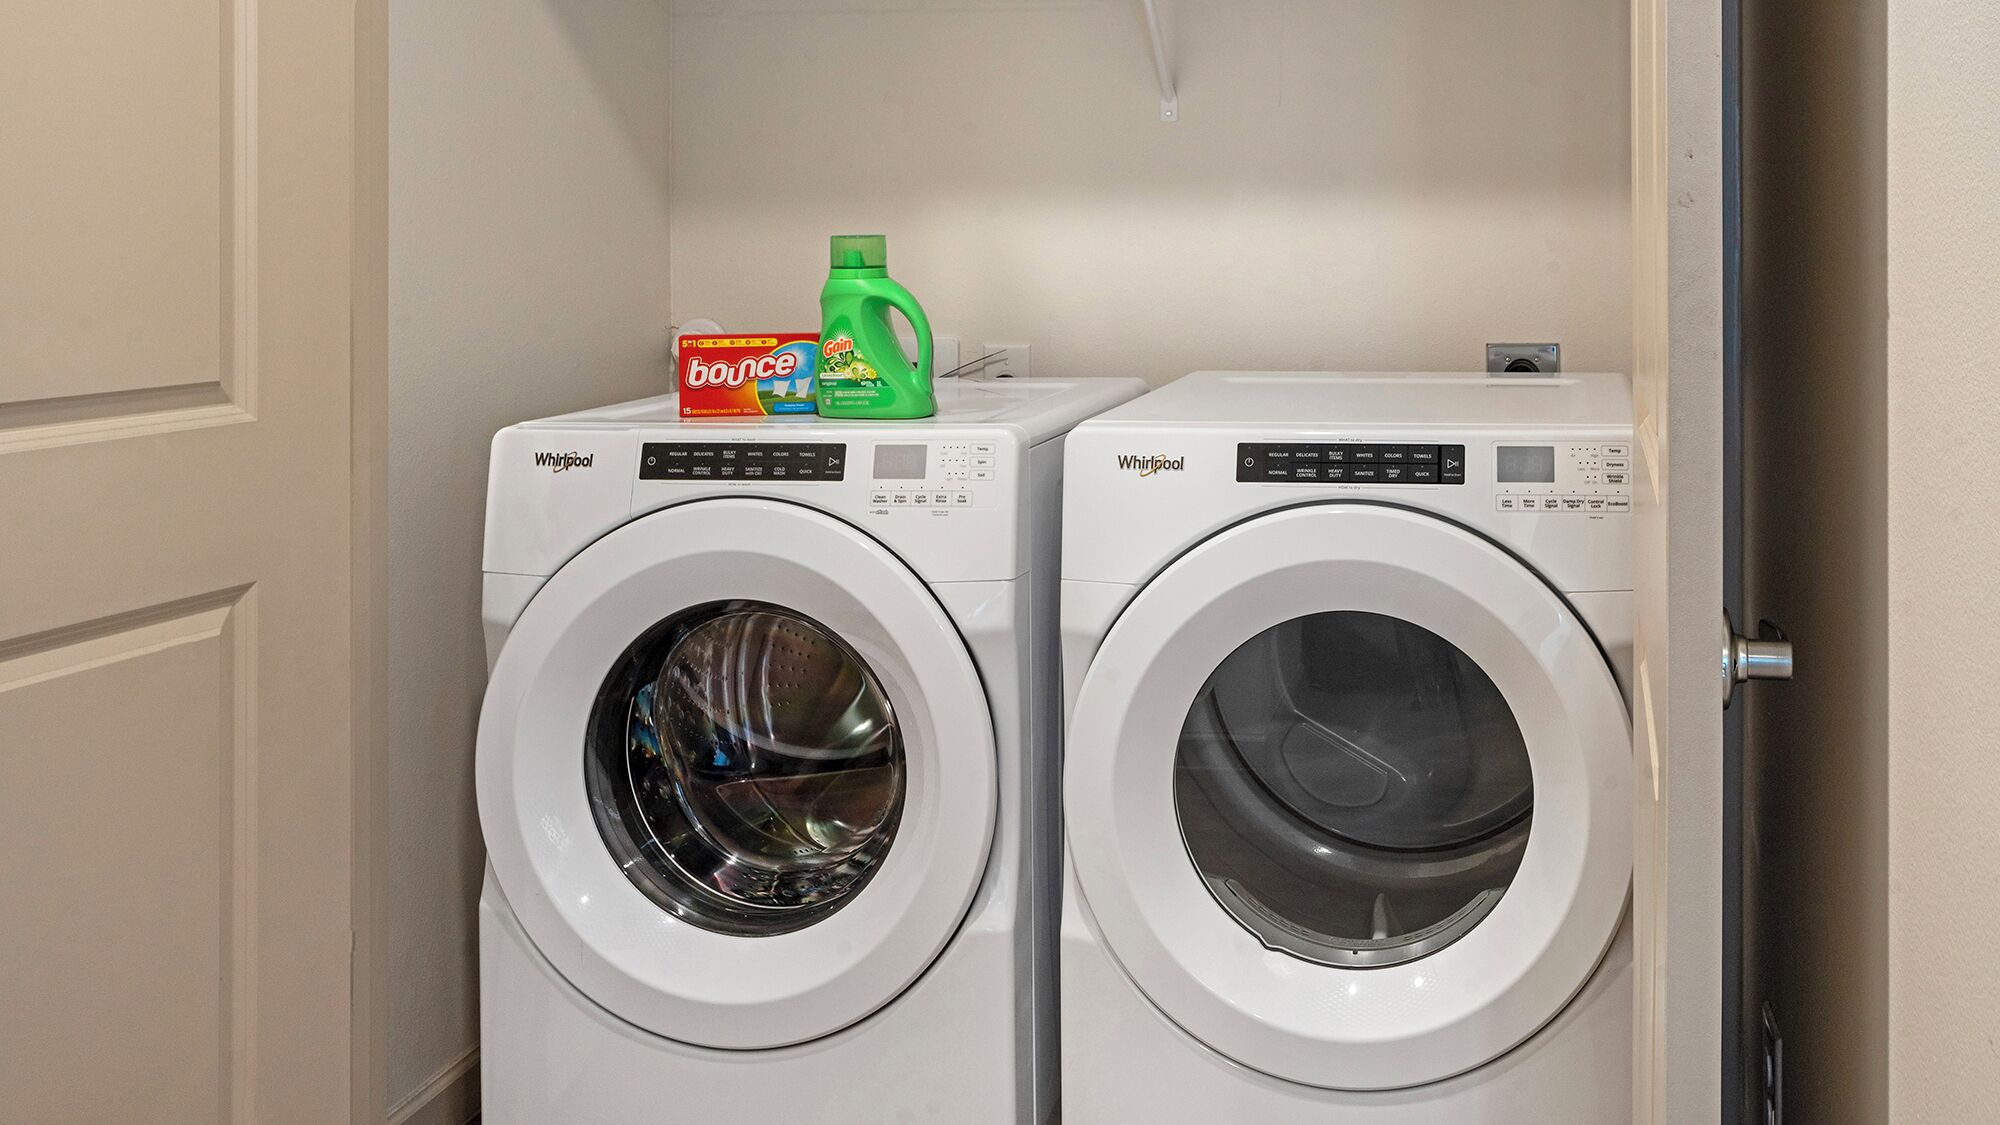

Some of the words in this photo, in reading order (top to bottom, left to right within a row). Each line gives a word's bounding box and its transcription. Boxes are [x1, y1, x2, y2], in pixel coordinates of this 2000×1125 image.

[823, 338, 853, 358] Gain
[687, 353, 796, 388] bounce
[535, 452, 594, 472] Whirlpool
[1118, 455, 1184, 475] Whirlpool
